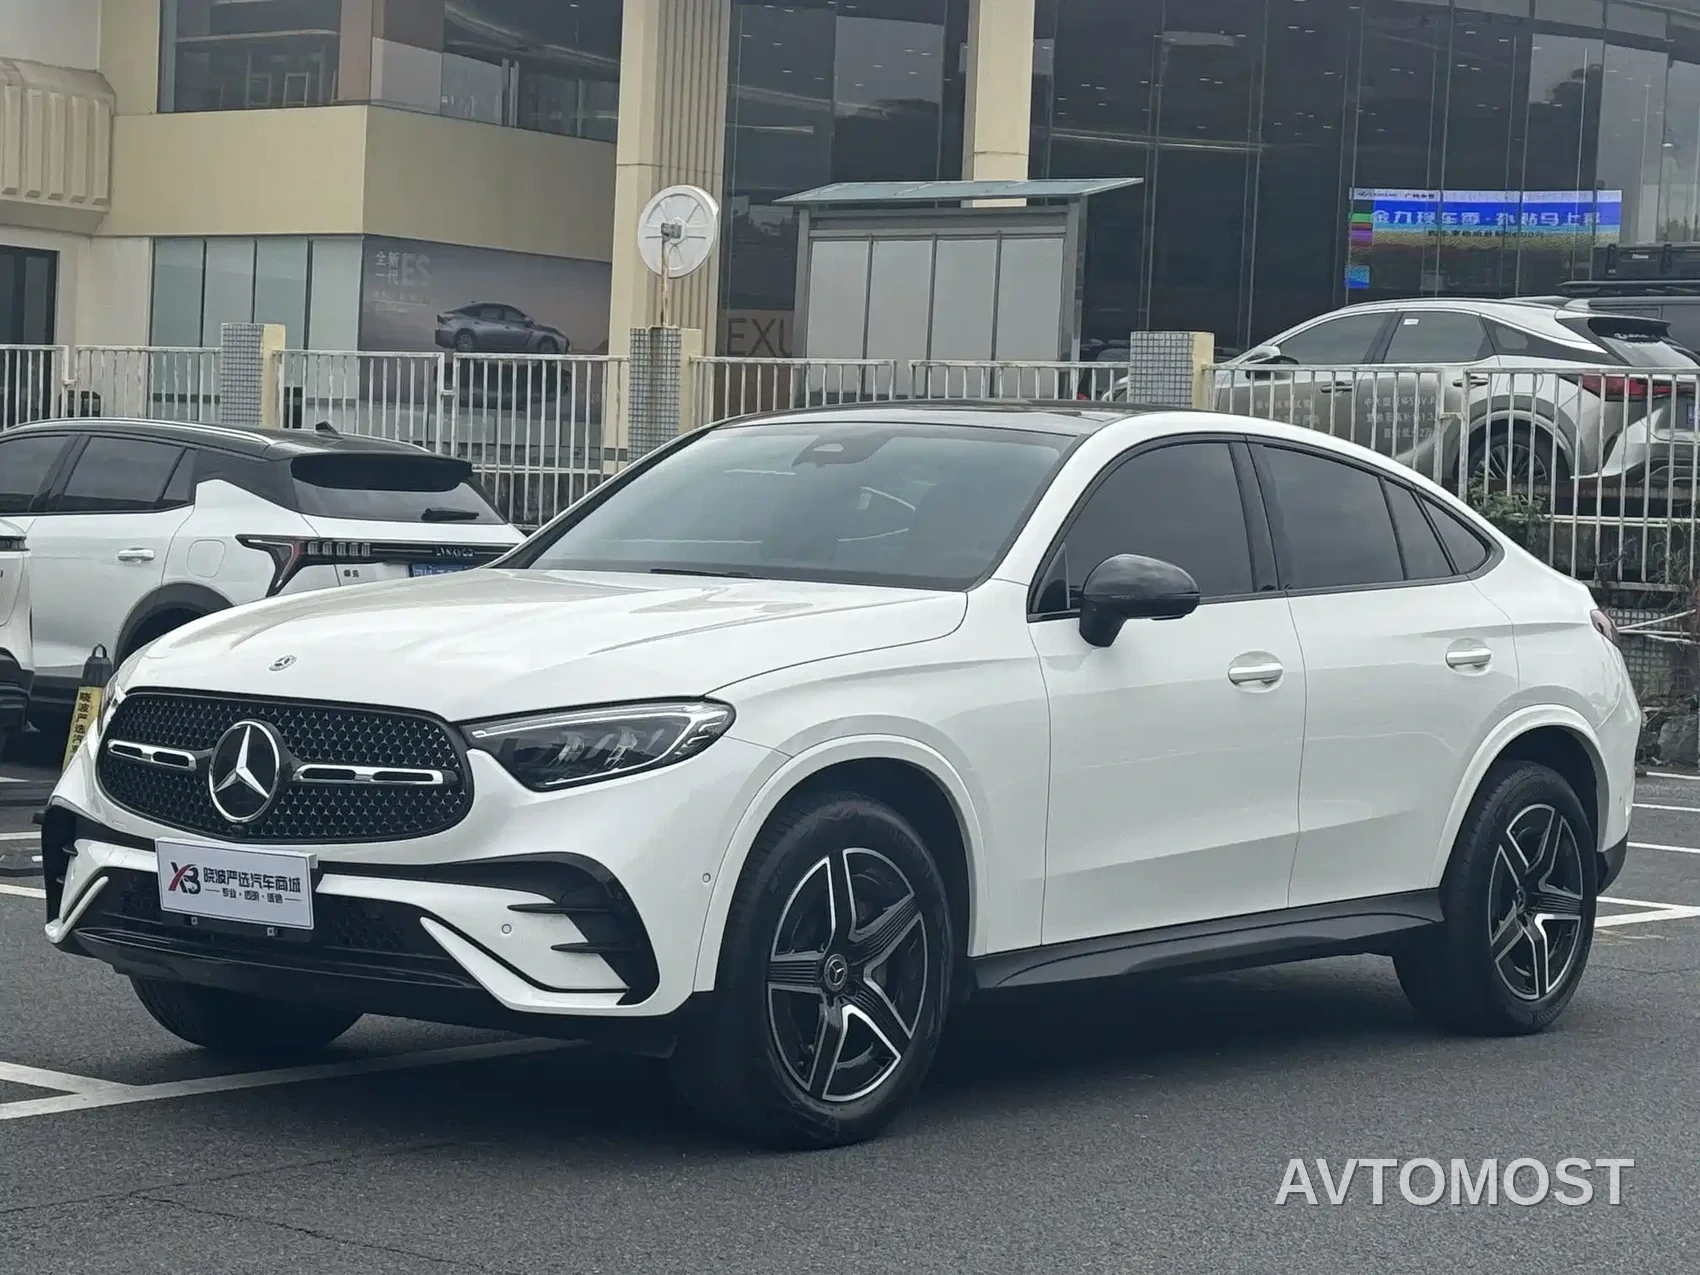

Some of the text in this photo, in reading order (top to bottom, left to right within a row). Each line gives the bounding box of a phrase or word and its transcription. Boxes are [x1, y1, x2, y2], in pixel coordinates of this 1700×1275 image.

[203, 867, 301, 893] 晓波严选汽车商城
